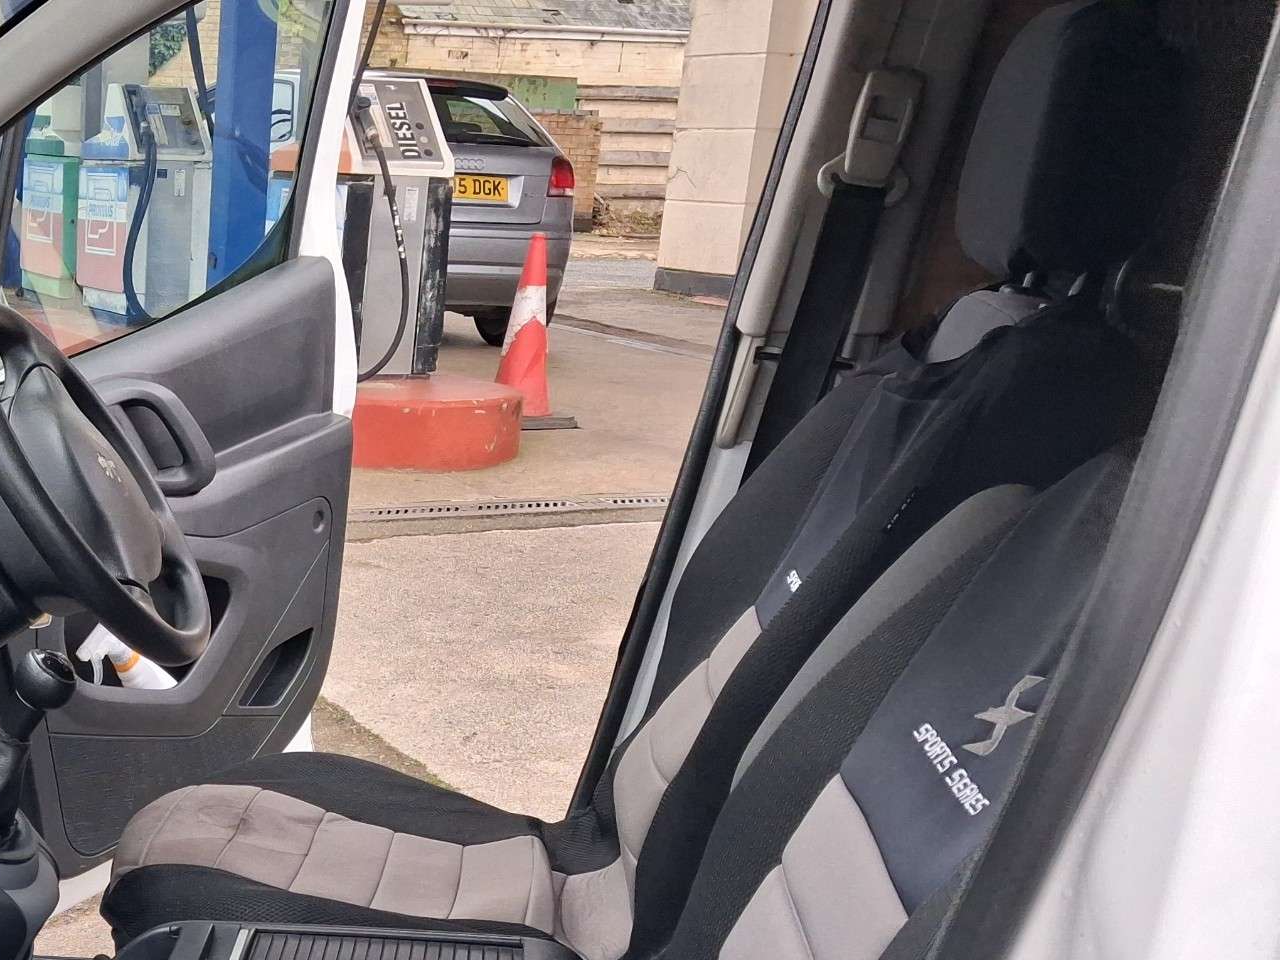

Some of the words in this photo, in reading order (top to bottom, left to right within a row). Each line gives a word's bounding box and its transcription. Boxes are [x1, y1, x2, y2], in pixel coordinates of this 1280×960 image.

[386, 102, 422, 159] DIESEL
[454, 177, 467, 194] 5
[472, 178, 502, 196] DGK
[912, 722, 958, 773] SPORTS
